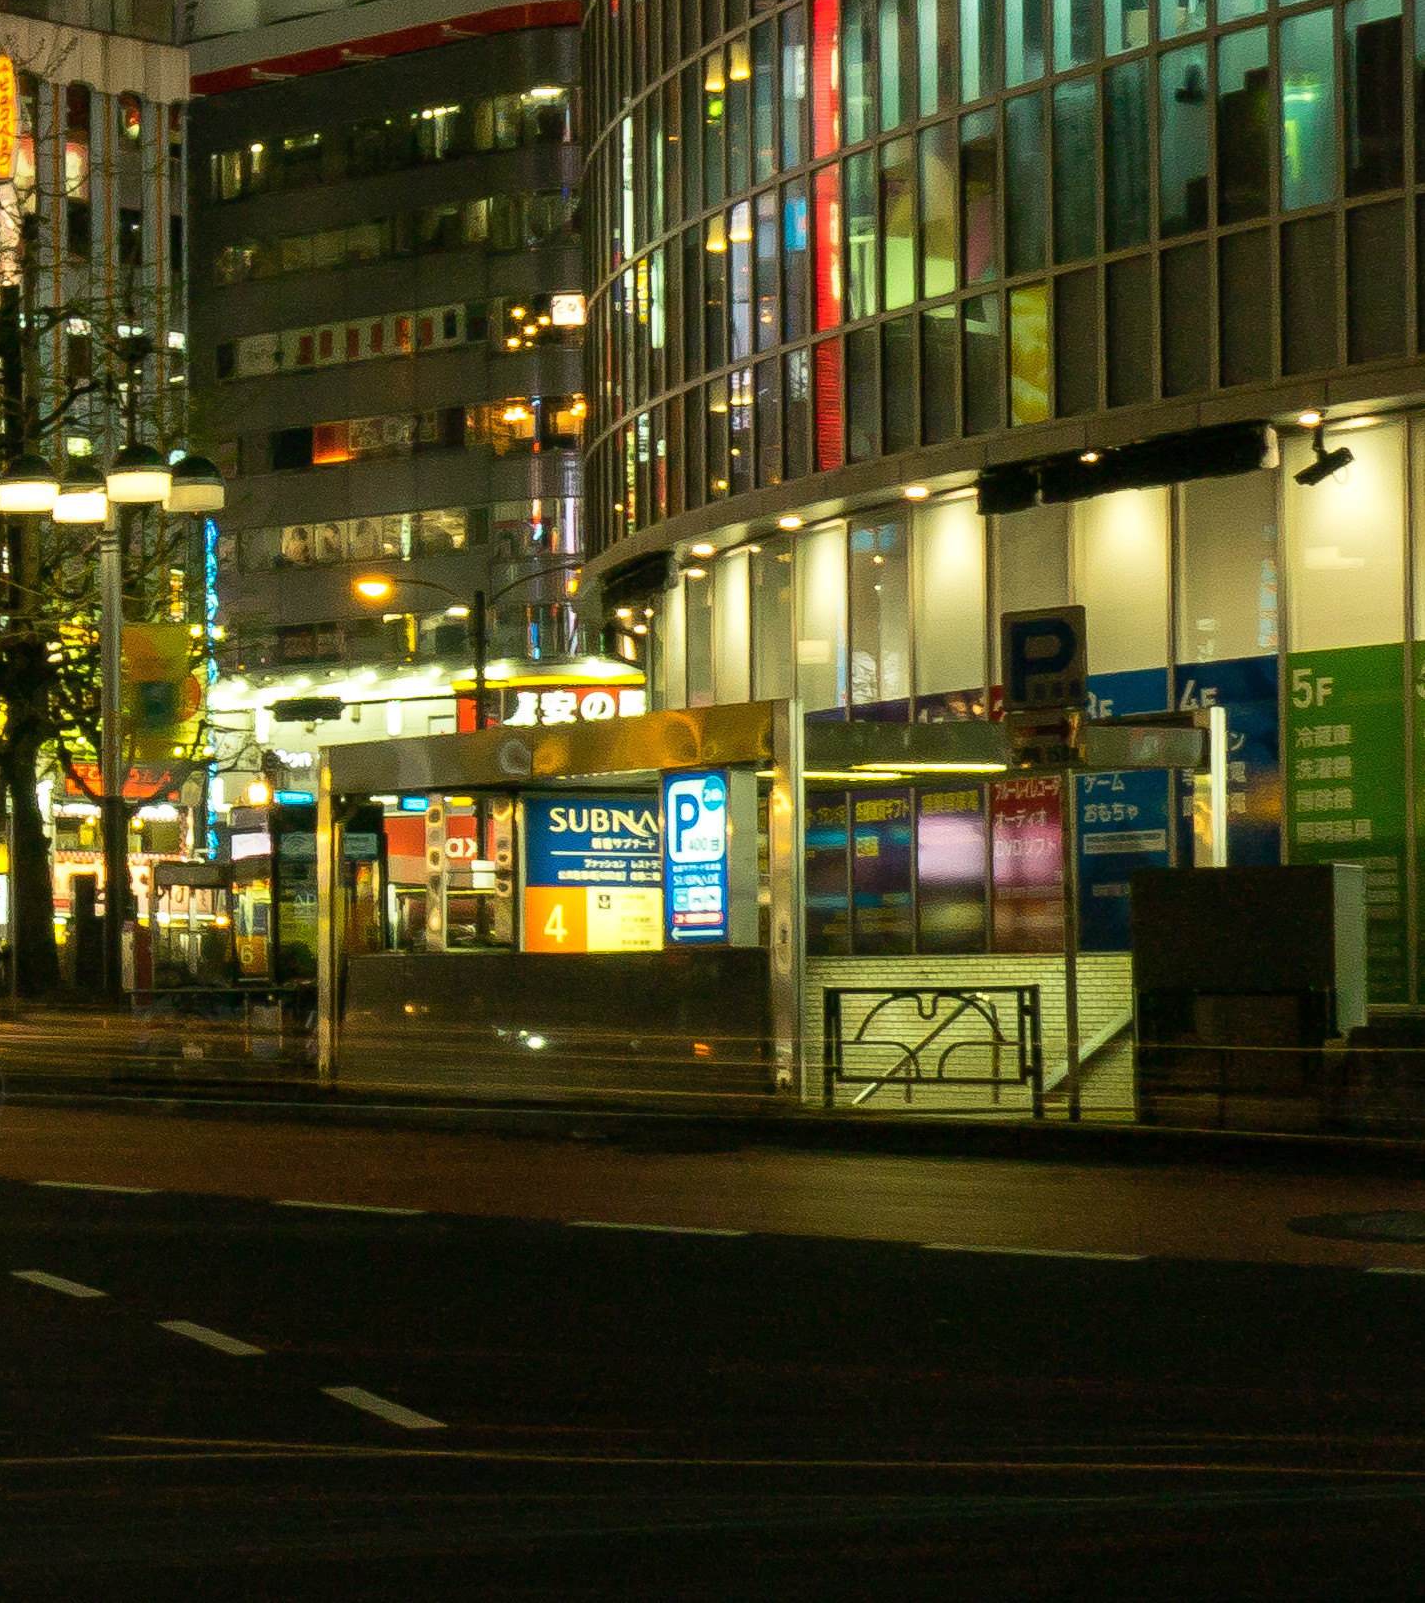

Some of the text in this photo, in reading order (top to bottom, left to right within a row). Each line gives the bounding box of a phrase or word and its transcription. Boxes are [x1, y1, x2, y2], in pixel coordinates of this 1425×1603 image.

[1011, 618, 1076, 702] P
[1292, 668, 1335, 708] 5F
[675, 793, 700, 853] P
[544, 903, 568, 943] 4
